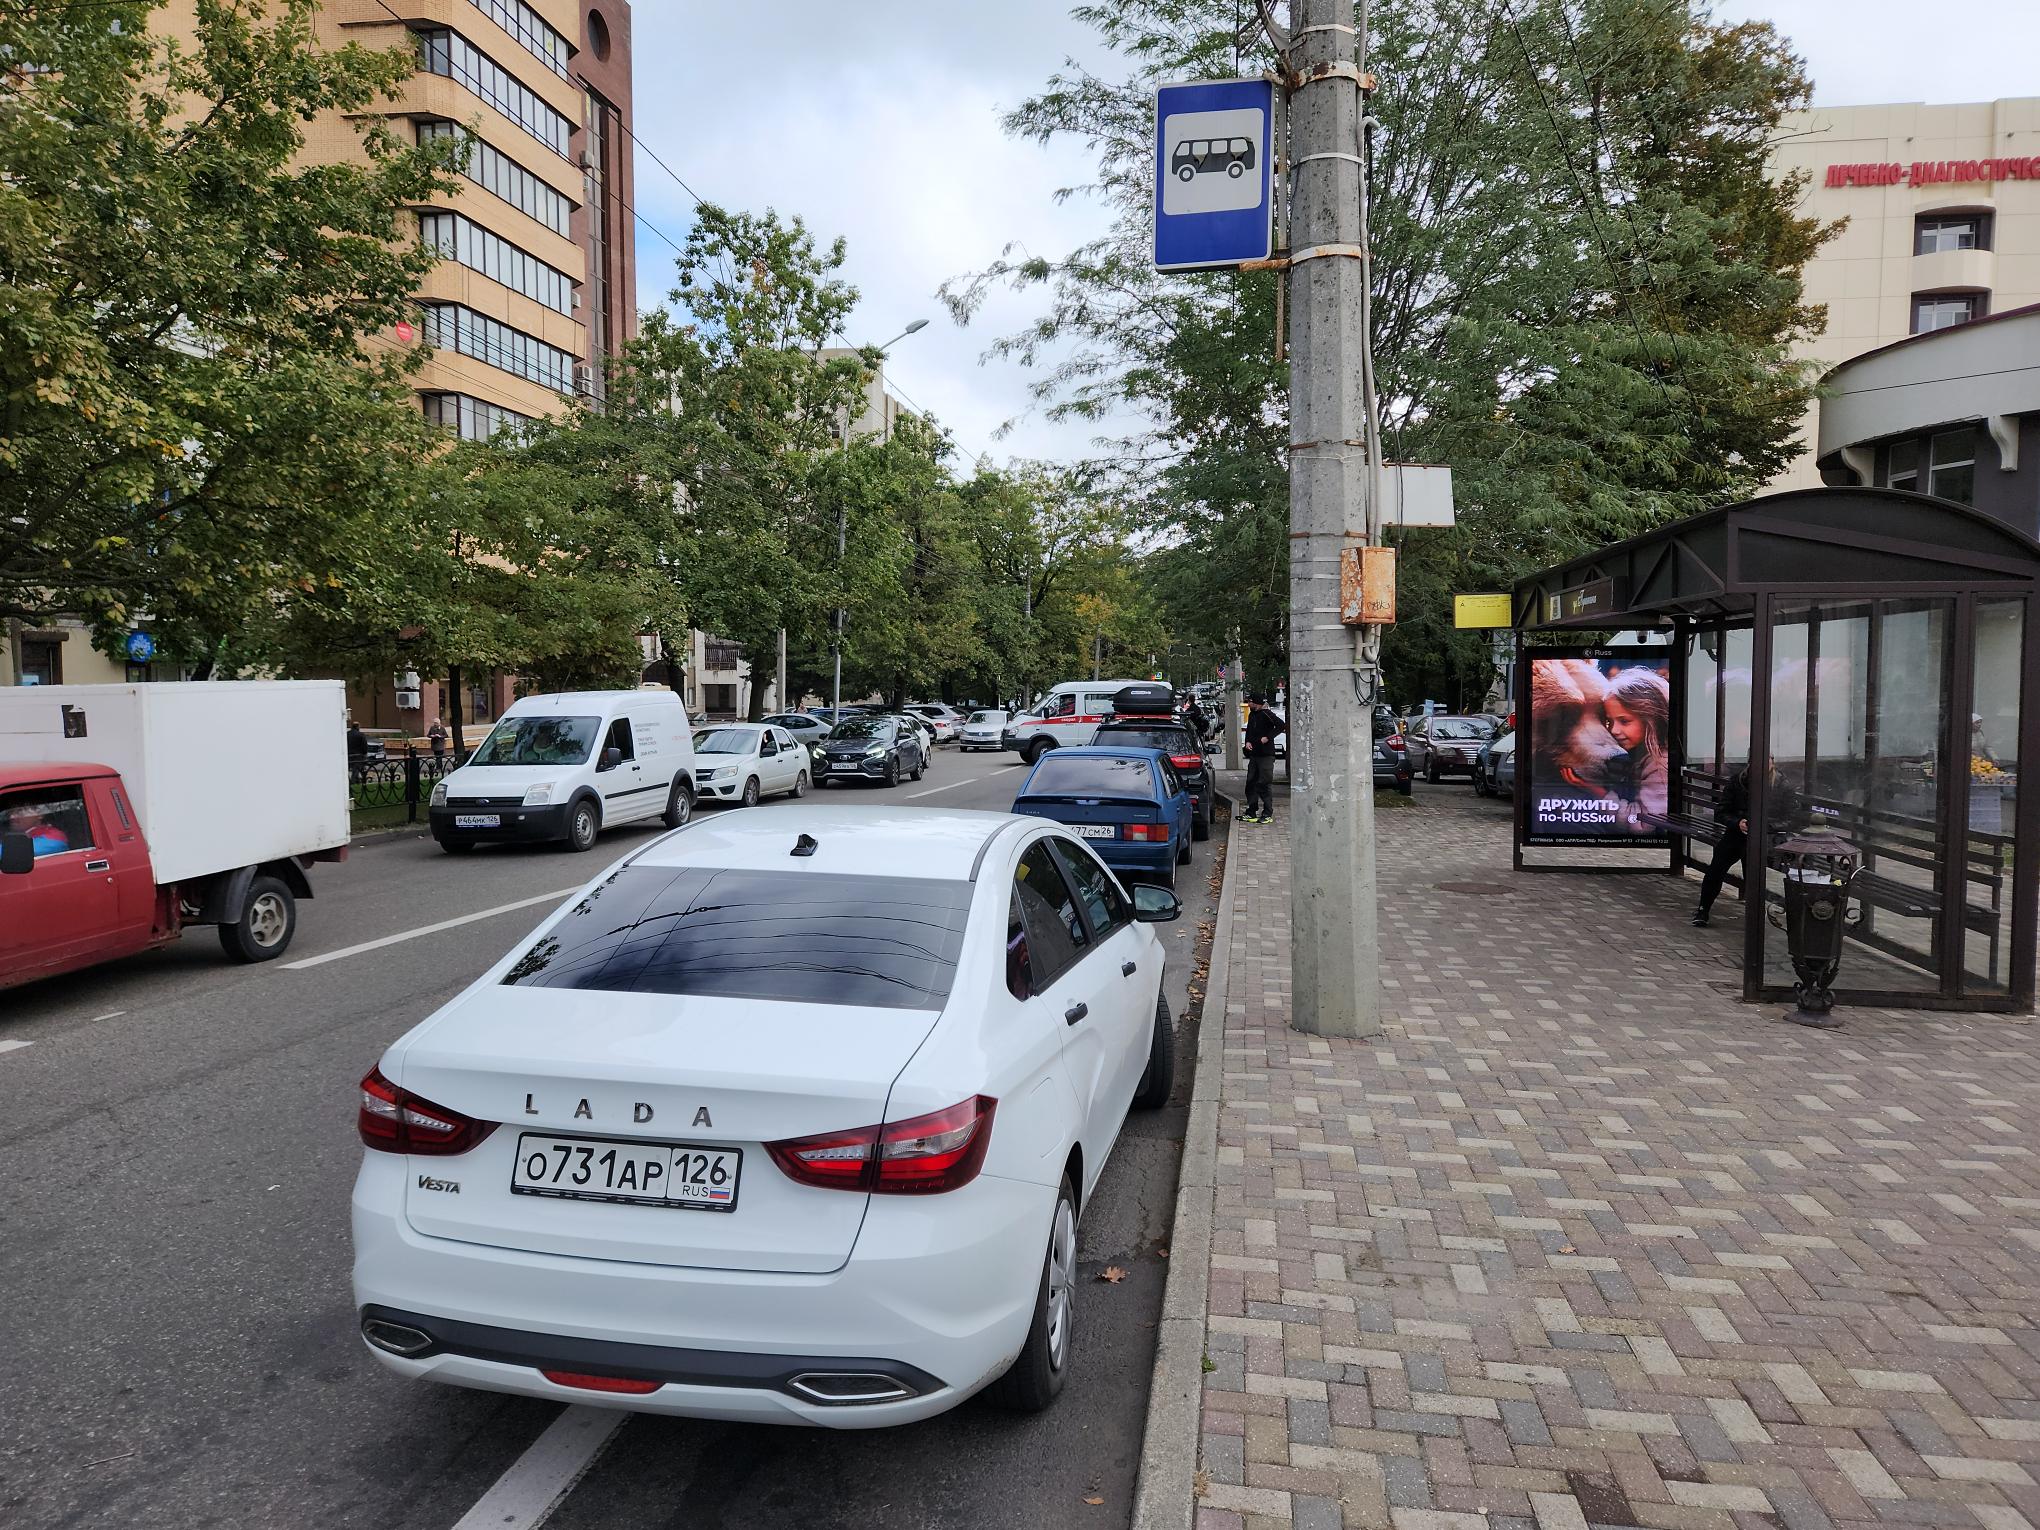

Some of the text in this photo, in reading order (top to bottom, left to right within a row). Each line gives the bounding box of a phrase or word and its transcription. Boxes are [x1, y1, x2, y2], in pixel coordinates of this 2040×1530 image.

[1538, 798, 1620, 812] ДРУЖИТЬ
[1539, 812, 1616, 823] по-RUSSки
[1101, 826, 1111, 834] 26
[525, 1093, 713, 1128] LADA
[526, 1145, 727, 1191] О731АР 126
[682, 1184, 709, 1197] RUS
